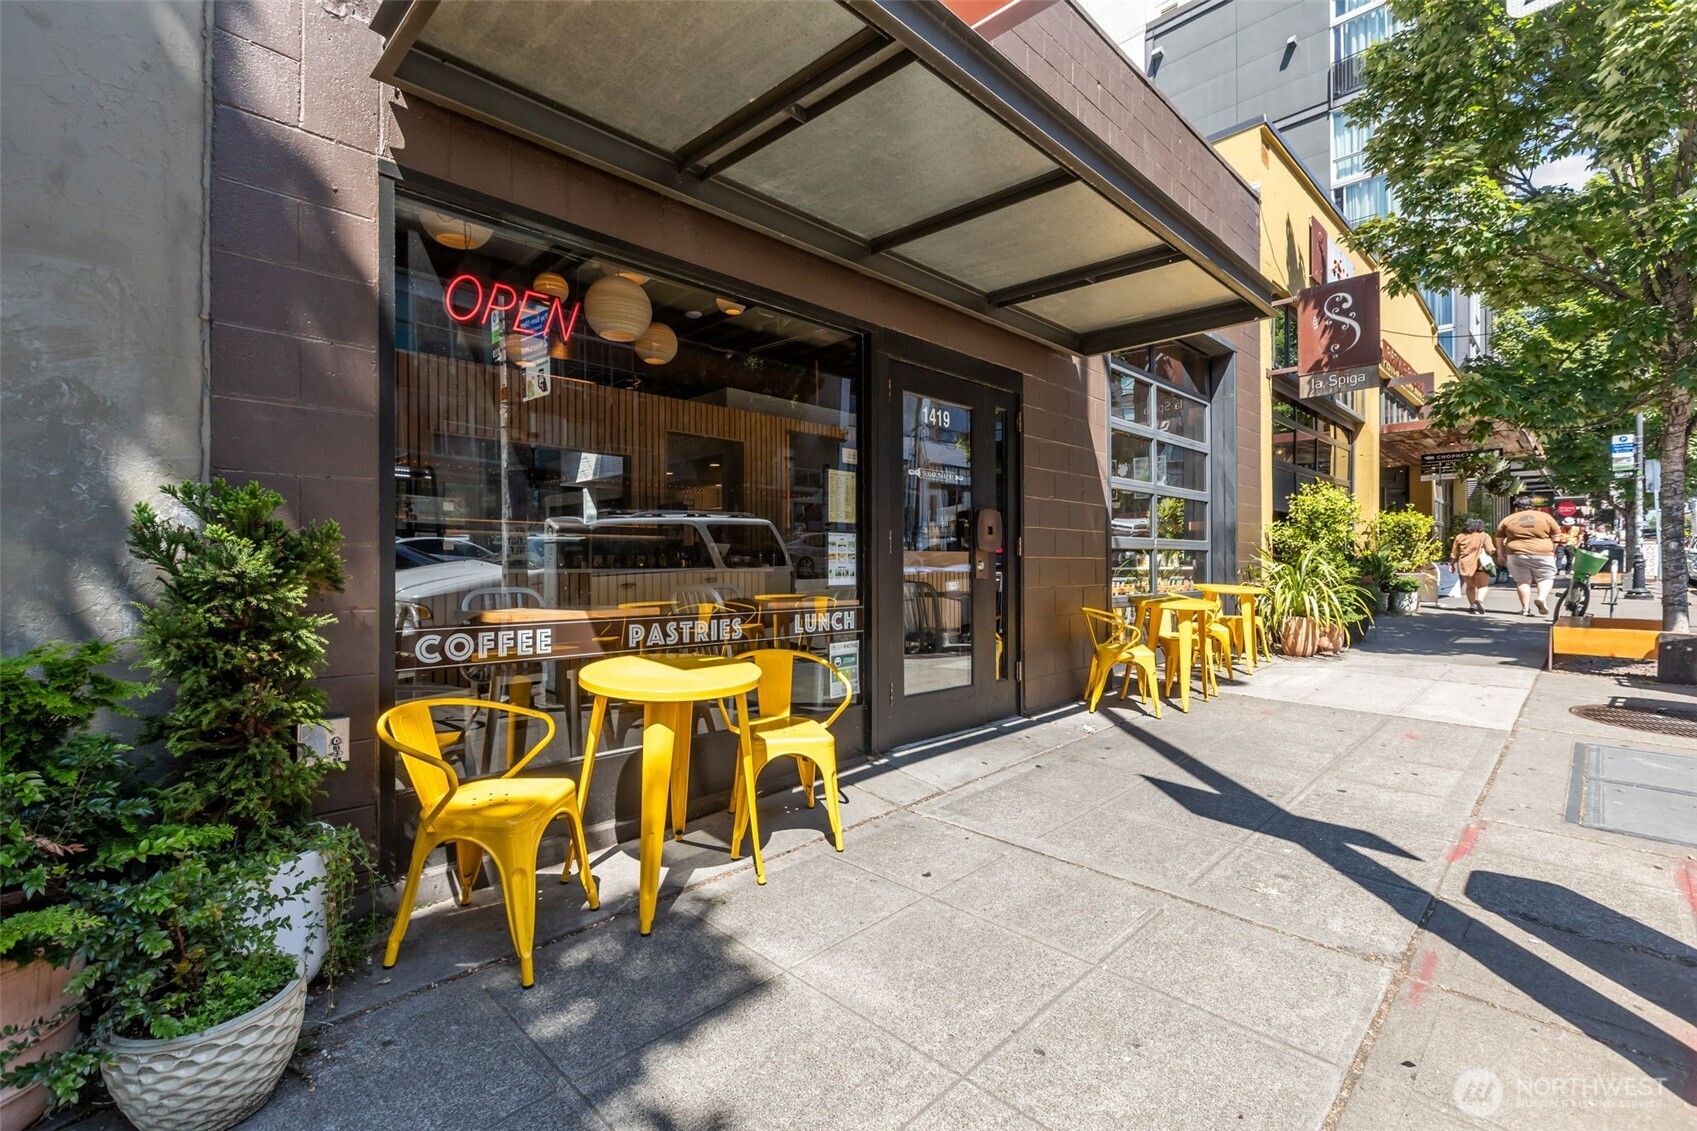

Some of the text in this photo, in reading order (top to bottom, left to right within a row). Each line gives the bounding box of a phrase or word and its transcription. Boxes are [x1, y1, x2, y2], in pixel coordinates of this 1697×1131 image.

[445, 274, 581, 342] OPEN
[1312, 373, 1366, 389] la Spiga
[923, 406, 950, 428] 1419
[628, 617, 743, 648] PASTRIES
[794, 610, 855, 634] LUNCH
[414, 628, 552, 663] COFFEE
